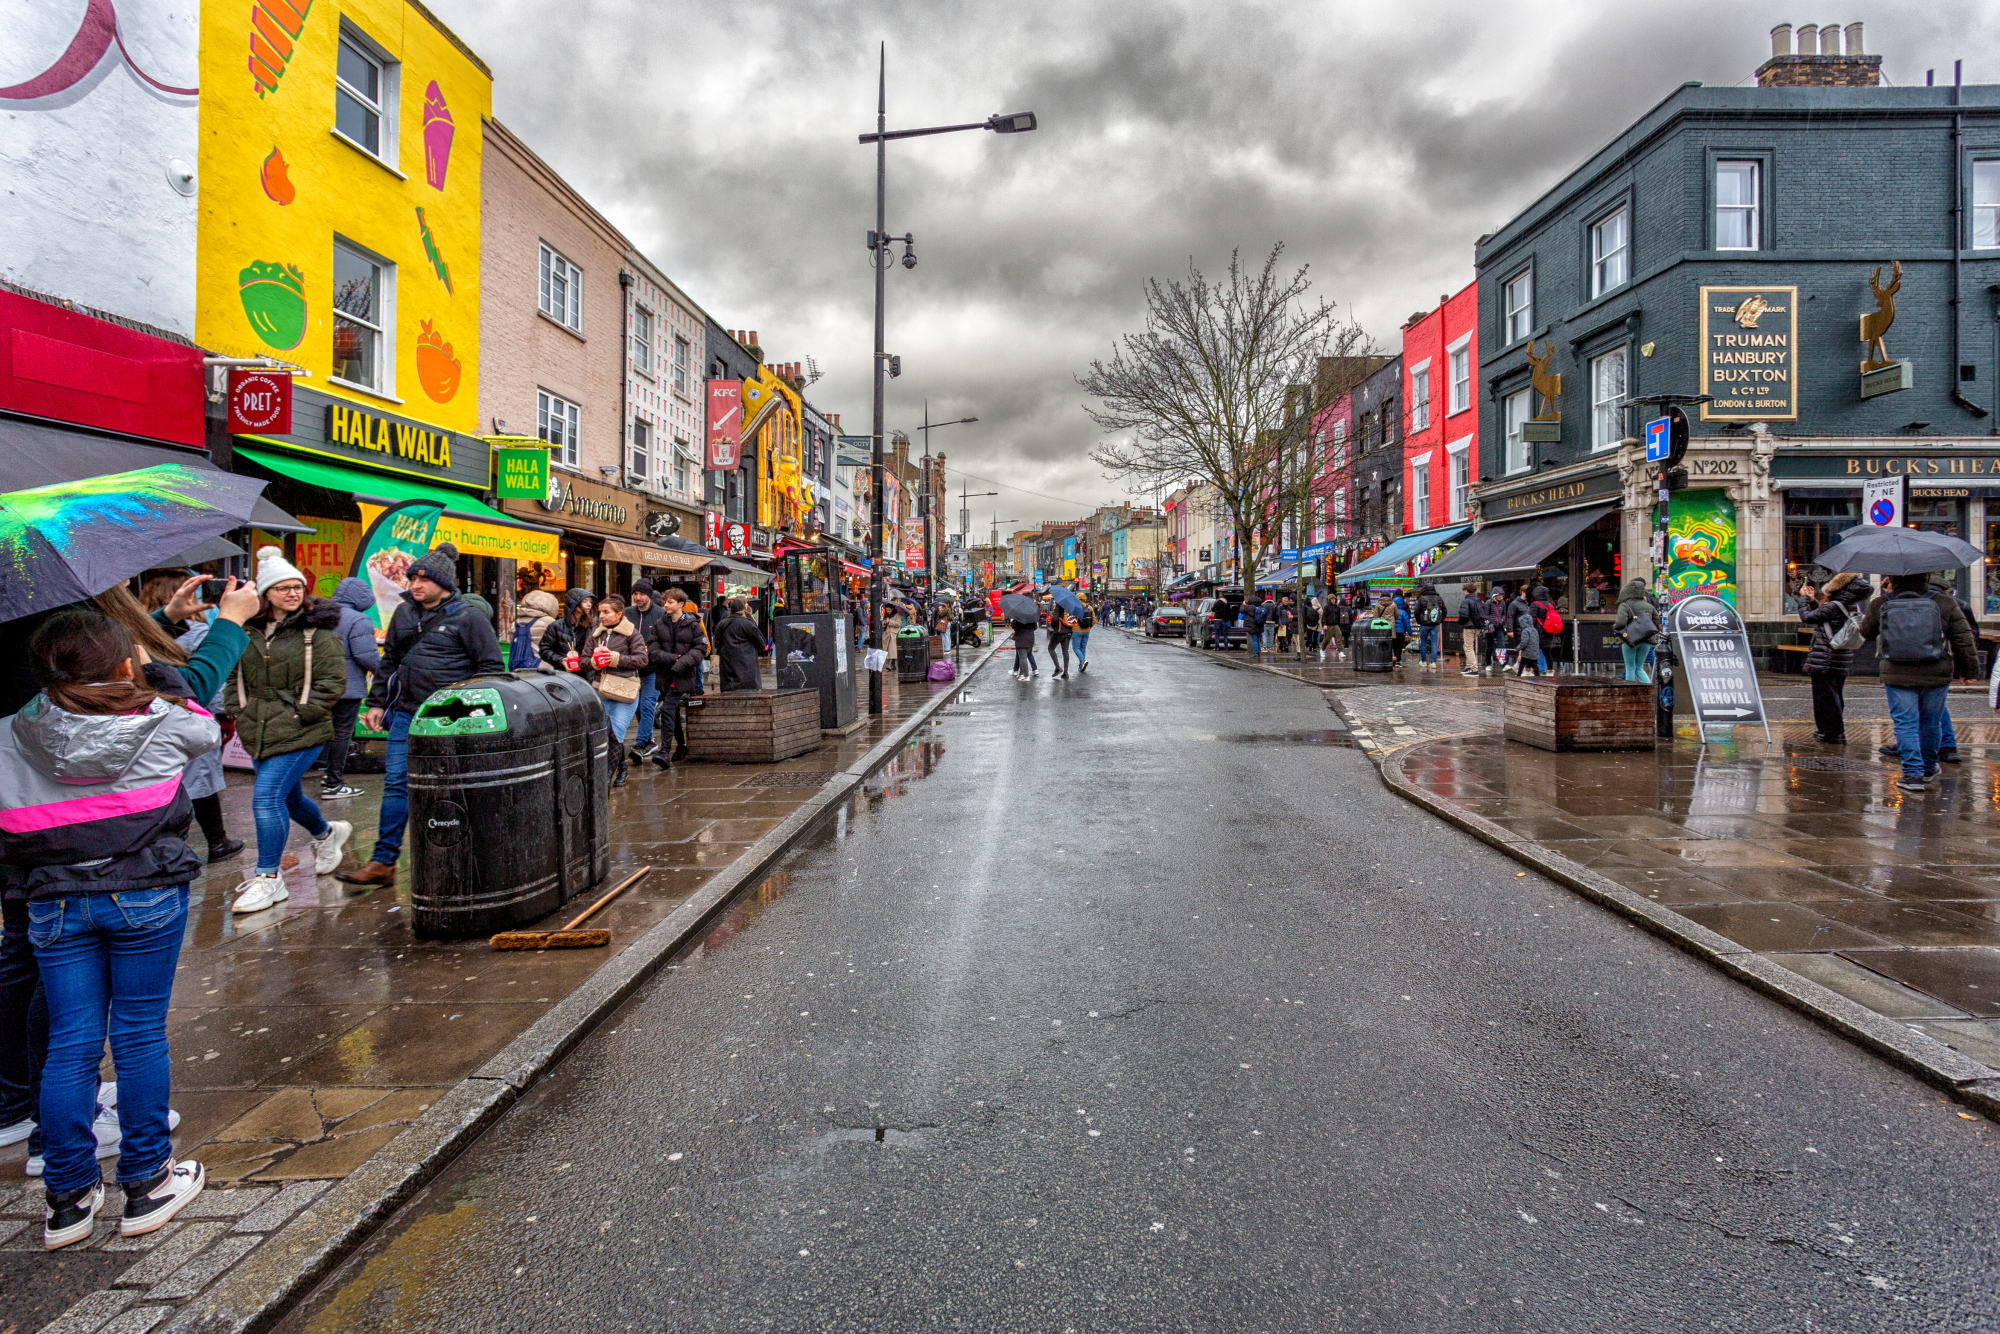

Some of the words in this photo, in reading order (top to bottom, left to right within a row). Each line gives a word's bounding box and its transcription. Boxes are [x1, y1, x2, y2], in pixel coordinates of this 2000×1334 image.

[1712, 334, 1787, 347] TRUMAN
[1712, 352, 1787, 364] HANBURY
[1713, 369, 1787, 382] BUXTON
[235, 376, 259, 393] ORGANIC
[260, 376, 280, 394] COFFEE
[1730, 387, 1738, 395] &
[712, 388, 737, 397] KFC
[244, 392, 272, 411] PRET
[1714, 400, 1744, 408] LONDON
[1747, 400, 1754, 408] &
[1755, 400, 1787, 408] BURTON
[233, 406, 254, 426] FRESHLY
[254, 419, 270, 427] MADE
[270, 406, 281, 422] FOOD
[331, 404, 391, 454] HALA
[395, 422, 451, 468] WALA
[506, 458, 538, 474] HALA
[1846, 459, 1940, 474] BUCKS
[505, 475, 540, 490] WALA
[1866, 479, 1900, 489] Restricted
[1507, 490, 1546, 510] BUCKS
[1548, 482, 1586, 502] HEAD
[1870, 488, 1894, 498] ZNE
[1912, 489, 1942, 497] BUCKS
[1943, 489, 1969, 497] HEAD
[559, 482, 626, 524] Amorino
[396, 514, 428, 533] HALA
[391, 525, 426, 545] WALA
[461, 528, 512, 550] hummus
[520, 537, 550, 554] falafel
[644, 551, 662, 562] GELATO
[668, 556, 690, 565] NATURALE
[1669, 587, 1691, 598] Good
[1694, 583, 1719, 592] Times
[1686, 614, 1729, 625] nemesis
[1692, 640, 1735, 652] TATTOO
[1691, 657, 1744, 670] PIERCING
[1700, 678, 1744, 690] TATTOO
[1700, 692, 1752, 704] REMOVAL
[437, 818, 460, 828] recycle
